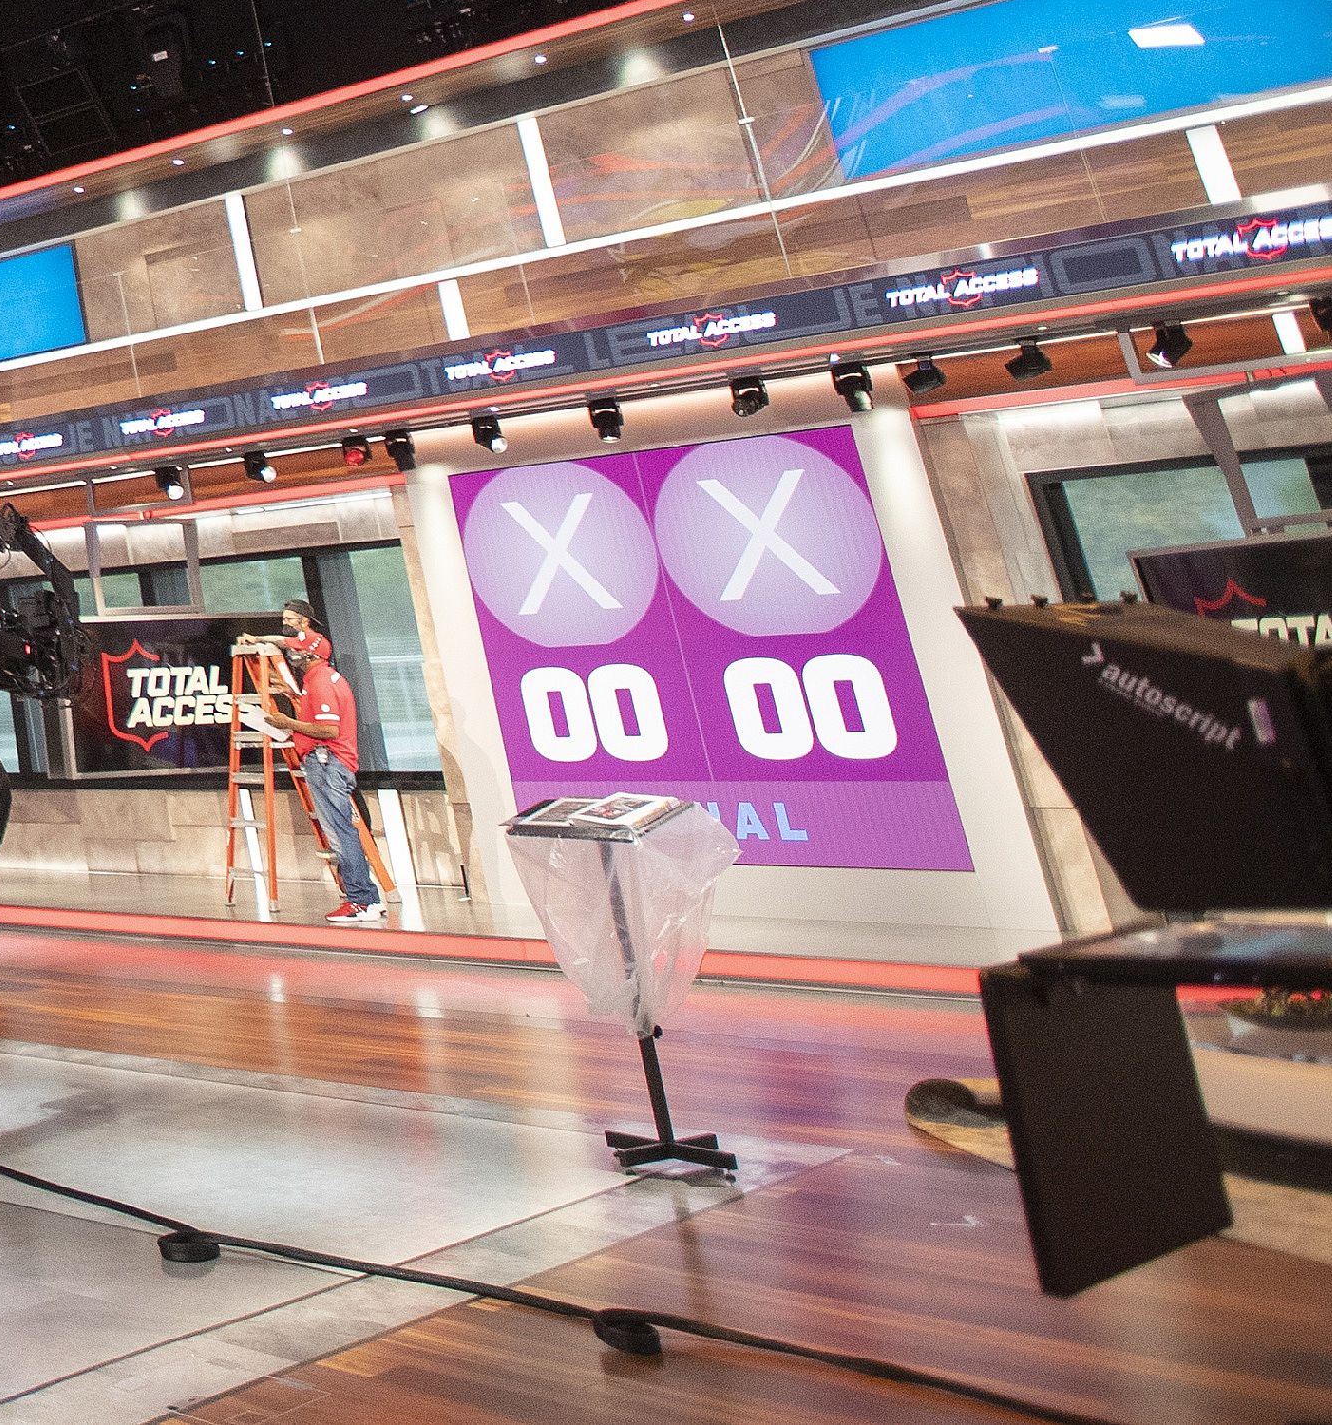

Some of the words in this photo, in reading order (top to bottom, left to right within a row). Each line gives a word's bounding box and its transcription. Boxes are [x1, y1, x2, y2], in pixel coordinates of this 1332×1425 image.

[1171, 232, 1249, 262] TOTAL
[886, 282, 951, 308] TOTAL
[953, 267, 1039, 298] ACCESS
[647, 324, 703, 347] TOTAL
[501, 492, 625, 616] X
[696, 469, 841, 601] X
[126, 665, 229, 698] TOTAL
[126, 693, 247, 728] ACCES
[520, 663, 669, 763] 00
[723, 654, 898, 760] 00
